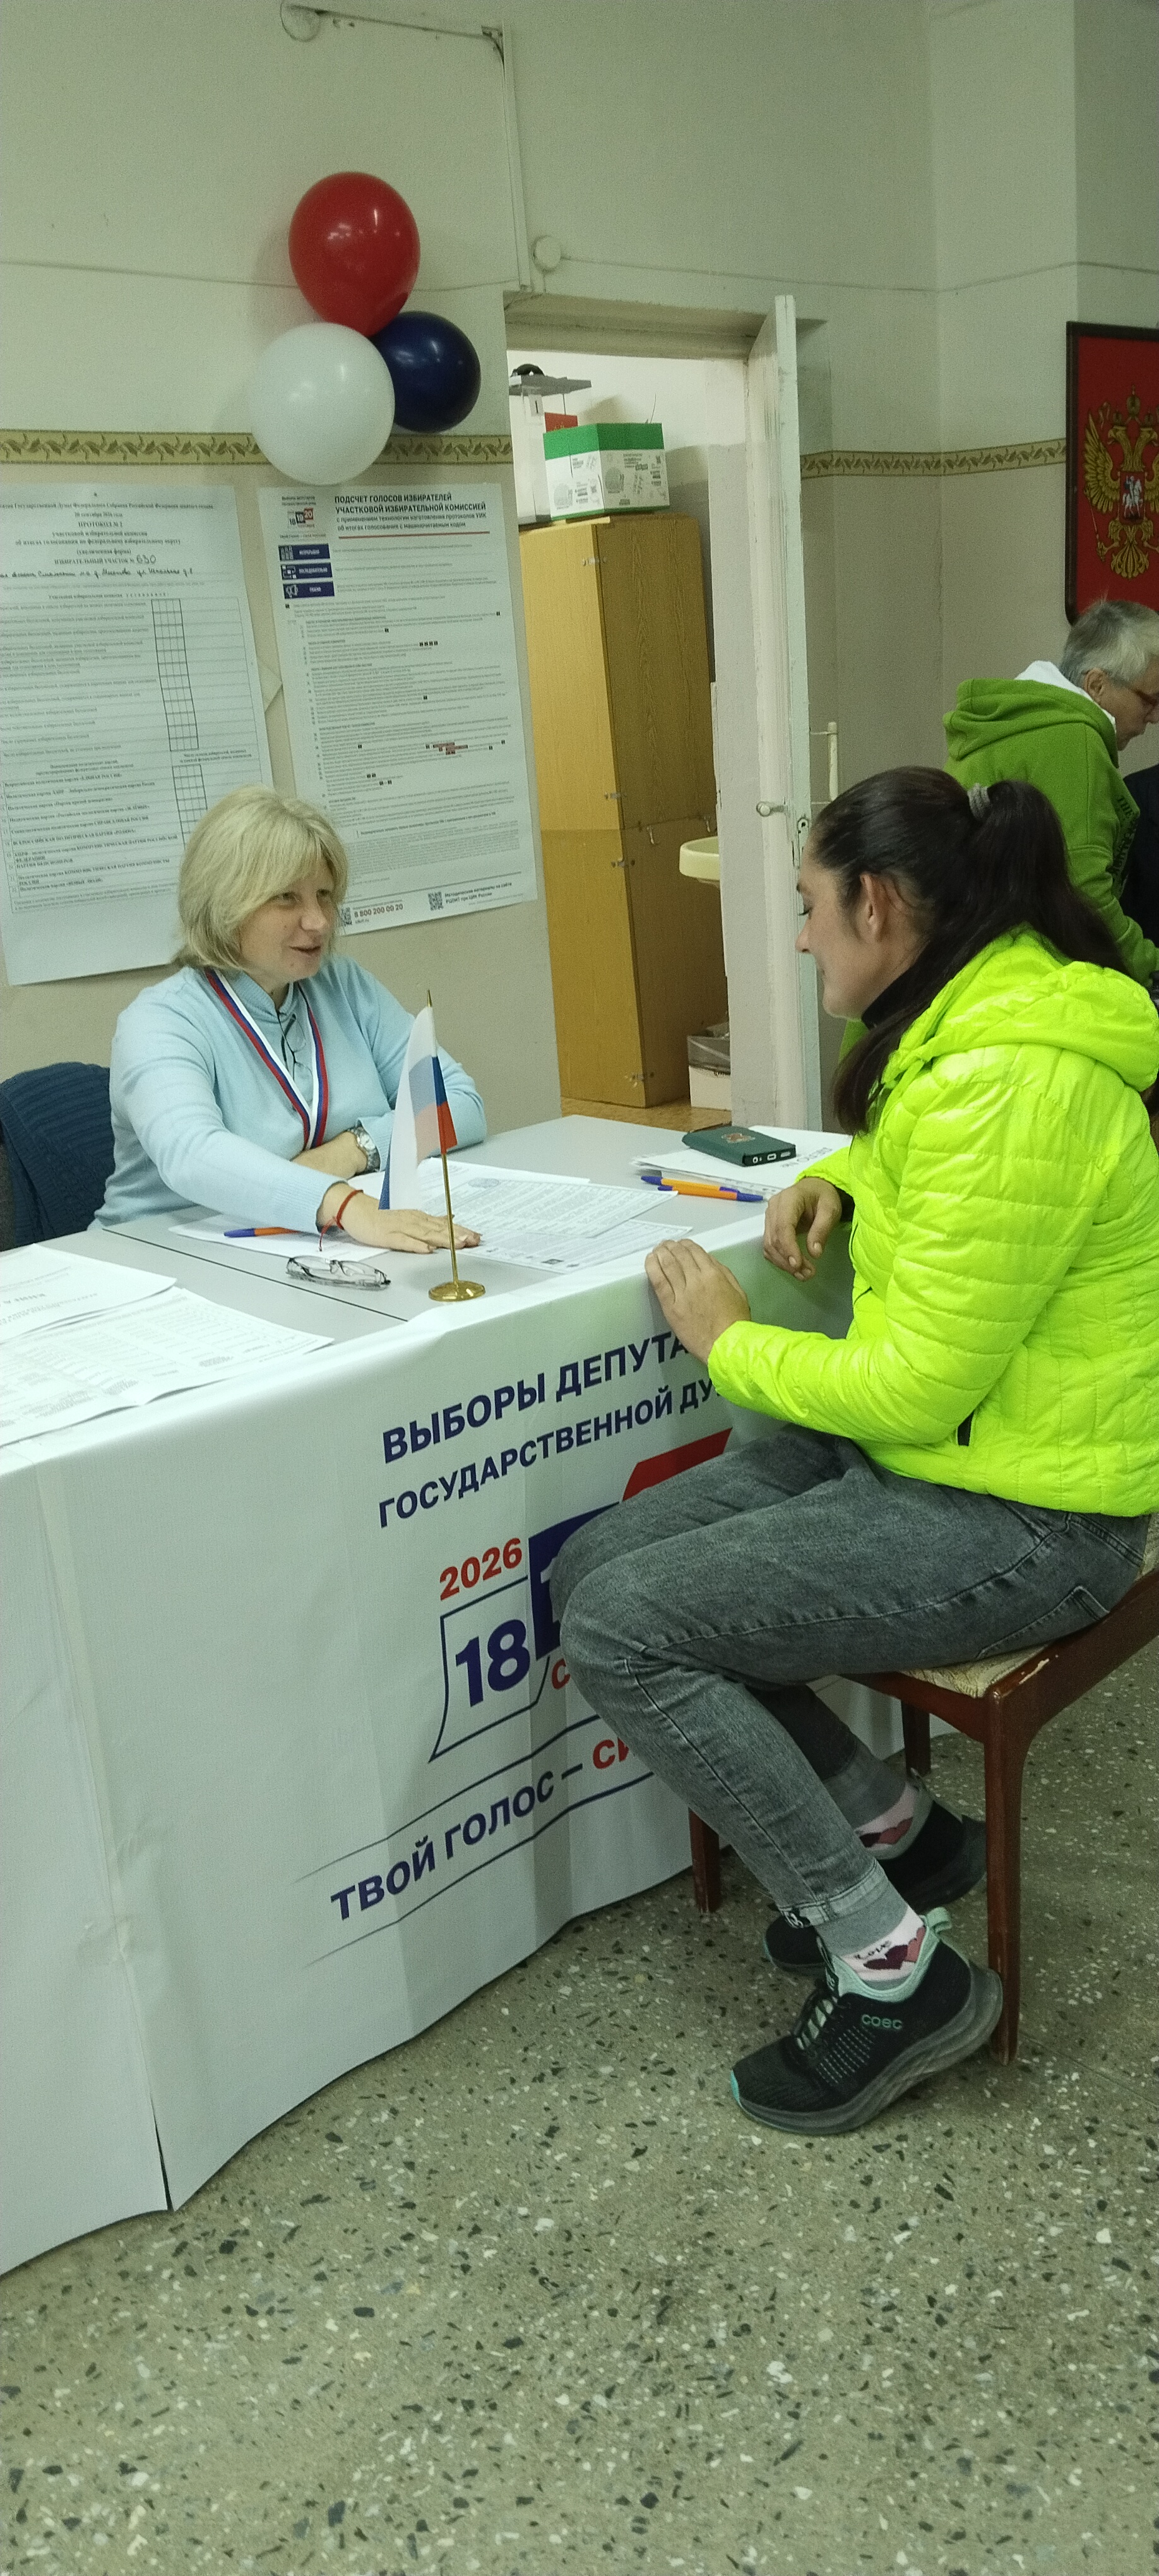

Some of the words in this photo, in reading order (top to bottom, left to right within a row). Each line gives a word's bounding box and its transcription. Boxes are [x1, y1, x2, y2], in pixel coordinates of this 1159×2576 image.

[304, 510, 312, 518] 20
[335, 495, 368, 504] ПОДСЧЕТ
[369, 494, 402, 503] ГОЛОСОВ
[403, 492, 452, 502] ИЗБИРАТЕЛЕЙ
[335, 504, 384, 514] УЧАСТКОВОЙ
[385, 503, 443, 512] ИЗБИРАТЕЛЬНОЙ
[445, 501, 486, 511] КОМИССИЕЙ
[136, 554, 157, 564] 630
[360, 909, 372, 917] 800
[374, 907, 384, 915] 200
[383, 1372, 545, 1464] ВЫБОРЫ
[556, 1331, 689, 1403] ДЕПУТА
[379, 1385, 672, 1529] ГОСУДАРСТВЕННОЙ
[680, 1378, 721, 1414] ДУ
[439, 1537, 522, 1601] 2026
[455, 1619, 530, 1707] 18
[330, 1835, 436, 1921] ТВОЙ
[444, 1771, 554, 1860] ГОЛОС
